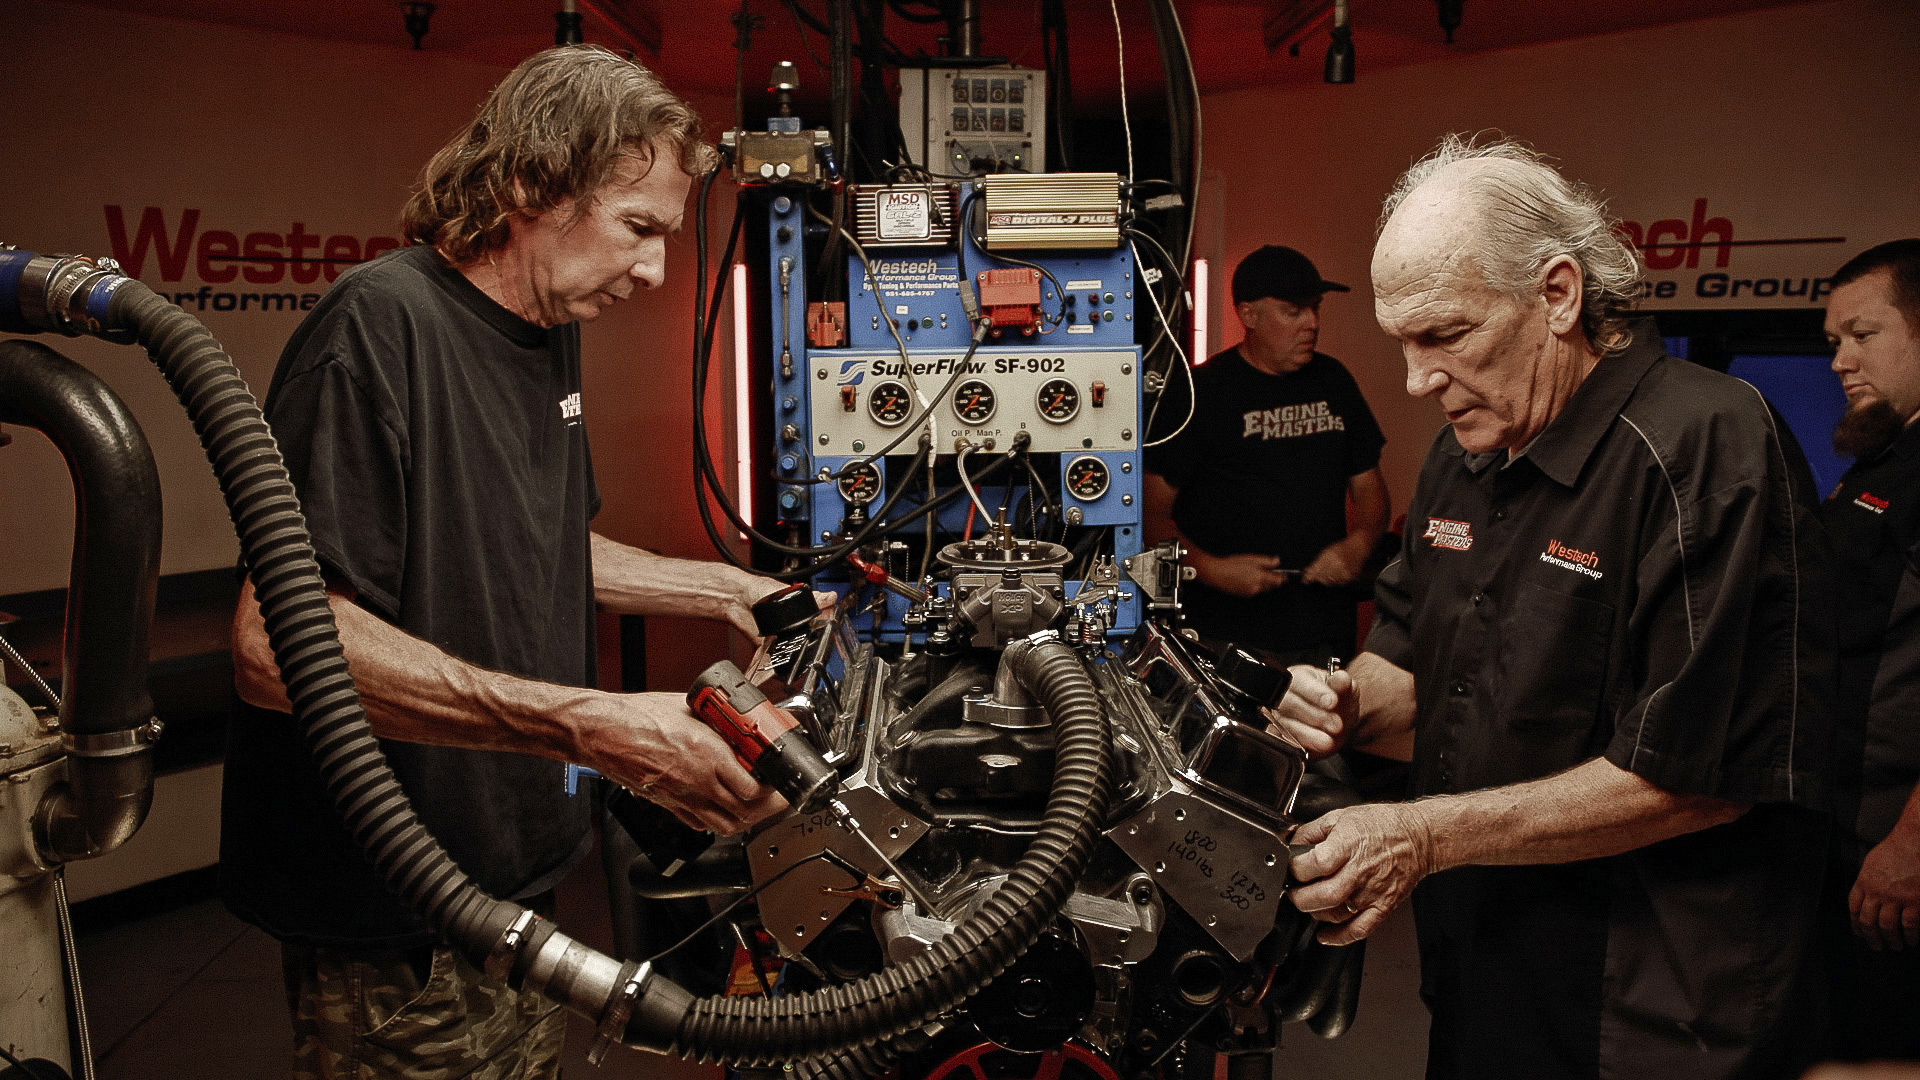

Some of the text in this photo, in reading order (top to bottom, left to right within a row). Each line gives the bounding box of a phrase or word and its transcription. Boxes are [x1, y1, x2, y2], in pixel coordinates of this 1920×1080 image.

[889, 193, 919, 204] MSD
[1078, 214, 1116, 224] PLUS
[865, 259, 937, 274] Westech
[927, 274, 957, 282] Group
[994, 358, 1066, 374] SF-902
[1243, 400, 1330, 438] ENGINE
[1262, 415, 1345, 441] MASTERS
[1425, 519, 1470, 537] ENGINE
[1547, 539, 1599, 568] Westech
[1575, 563, 1603, 581] Group
